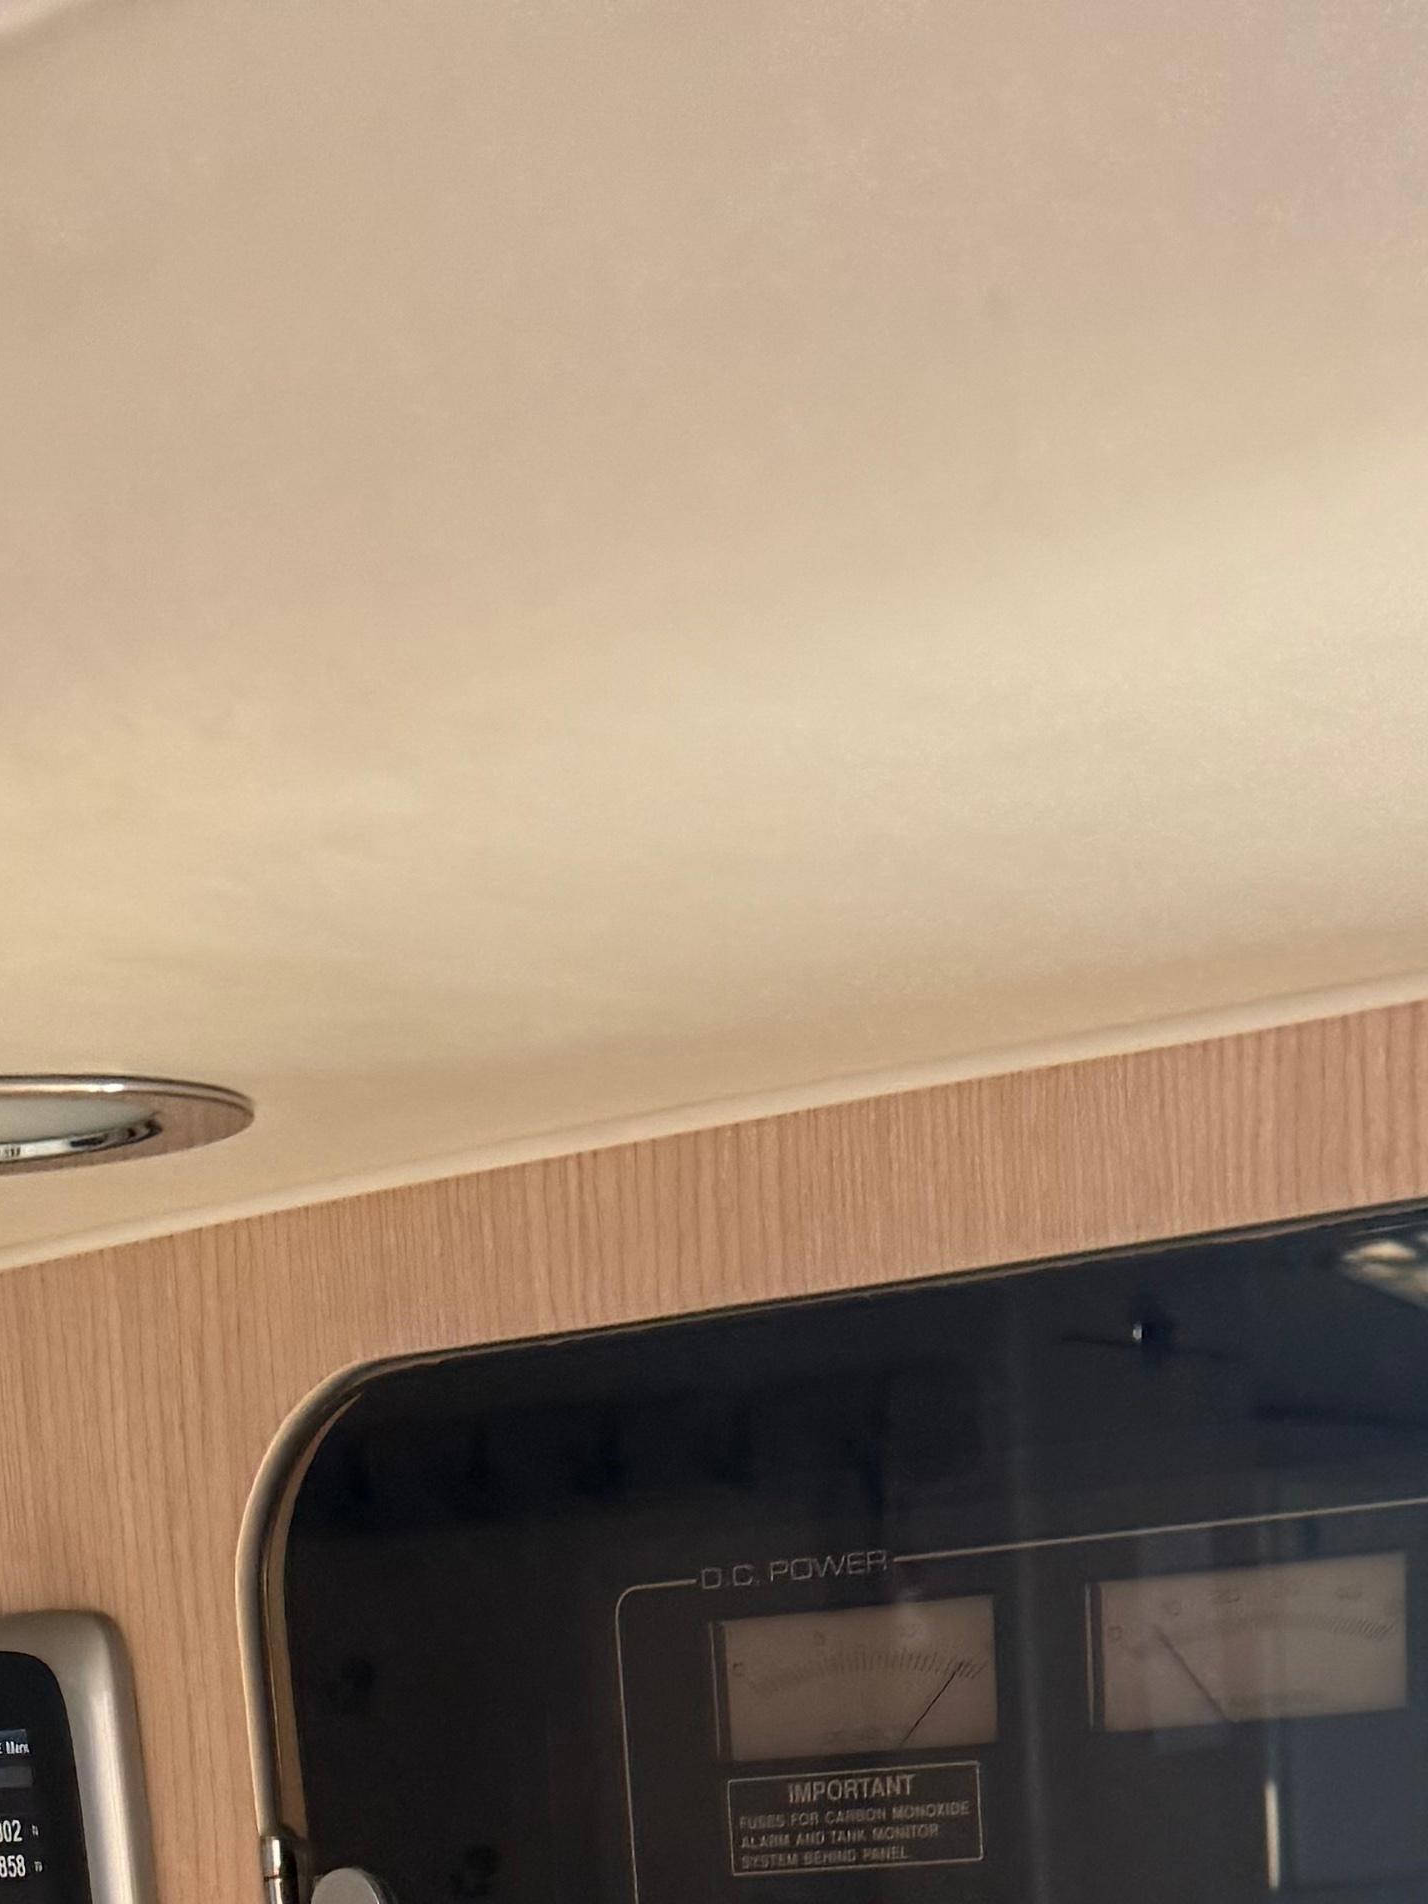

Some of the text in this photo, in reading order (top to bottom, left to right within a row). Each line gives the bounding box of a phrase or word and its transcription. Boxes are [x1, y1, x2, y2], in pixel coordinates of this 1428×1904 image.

[700, 1549, 889, 1591] D.C. POWER
[788, 1774, 915, 1804] IMPORTANT
[739, 1800, 972, 1831] FUSES FOR CARBON MONOXIDE
[741, 1823, 940, 1850] ALARM AND TANK MONITOR
[741, 1846, 909, 1869] SYSTEM BEHIND PANEL
